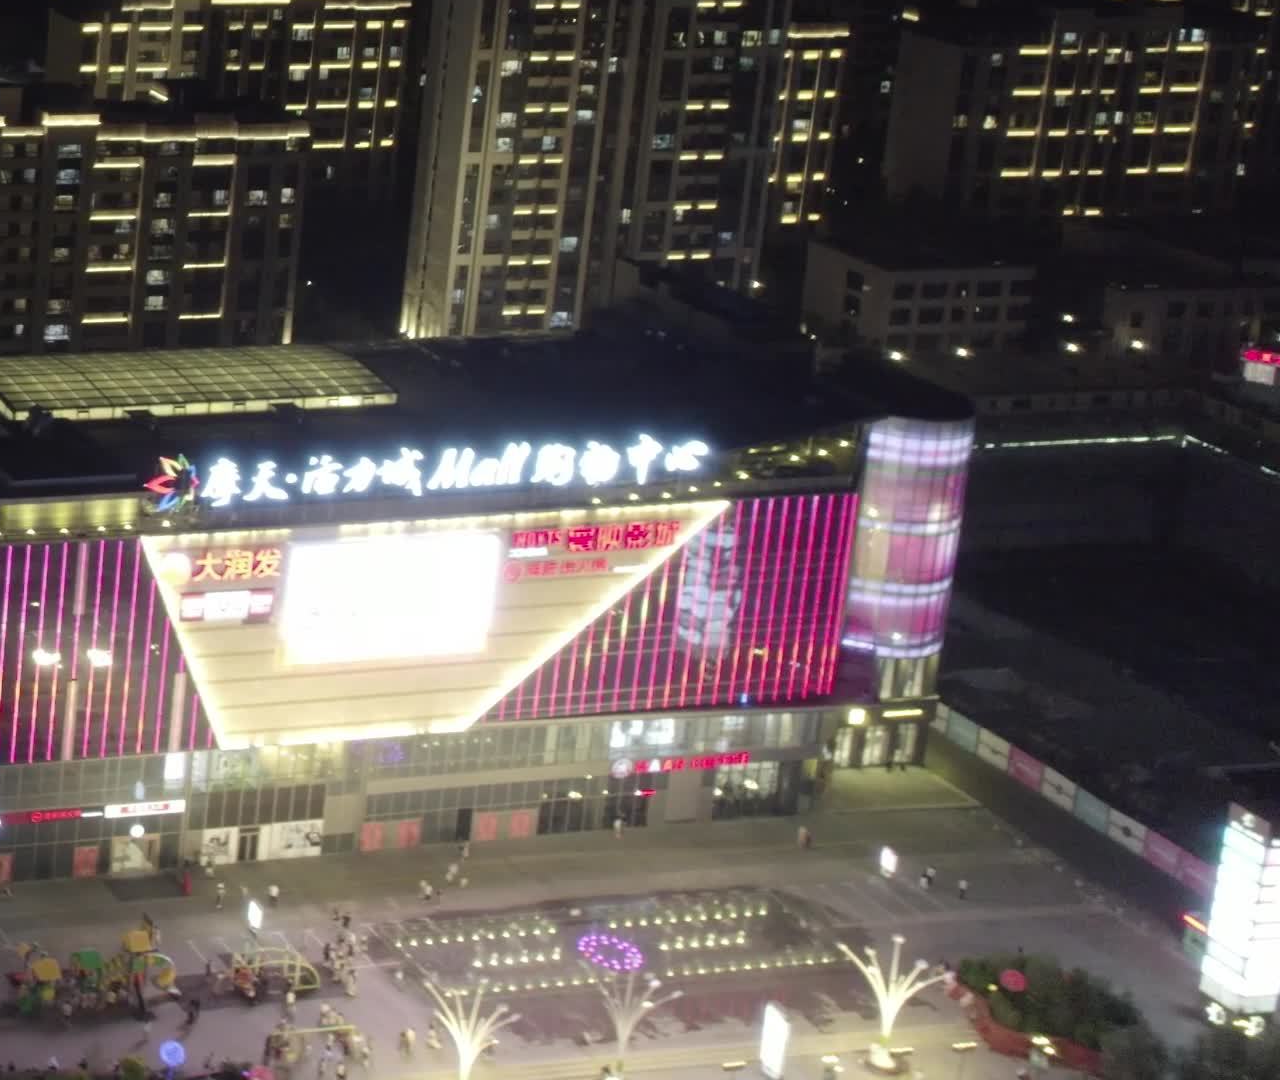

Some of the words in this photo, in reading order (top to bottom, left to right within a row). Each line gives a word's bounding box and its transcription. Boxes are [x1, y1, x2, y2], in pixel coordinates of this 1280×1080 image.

[427, 441, 531, 491] Mall
[536, 434, 708, 485] 购物中心
[192, 548, 282, 581] 大润发
